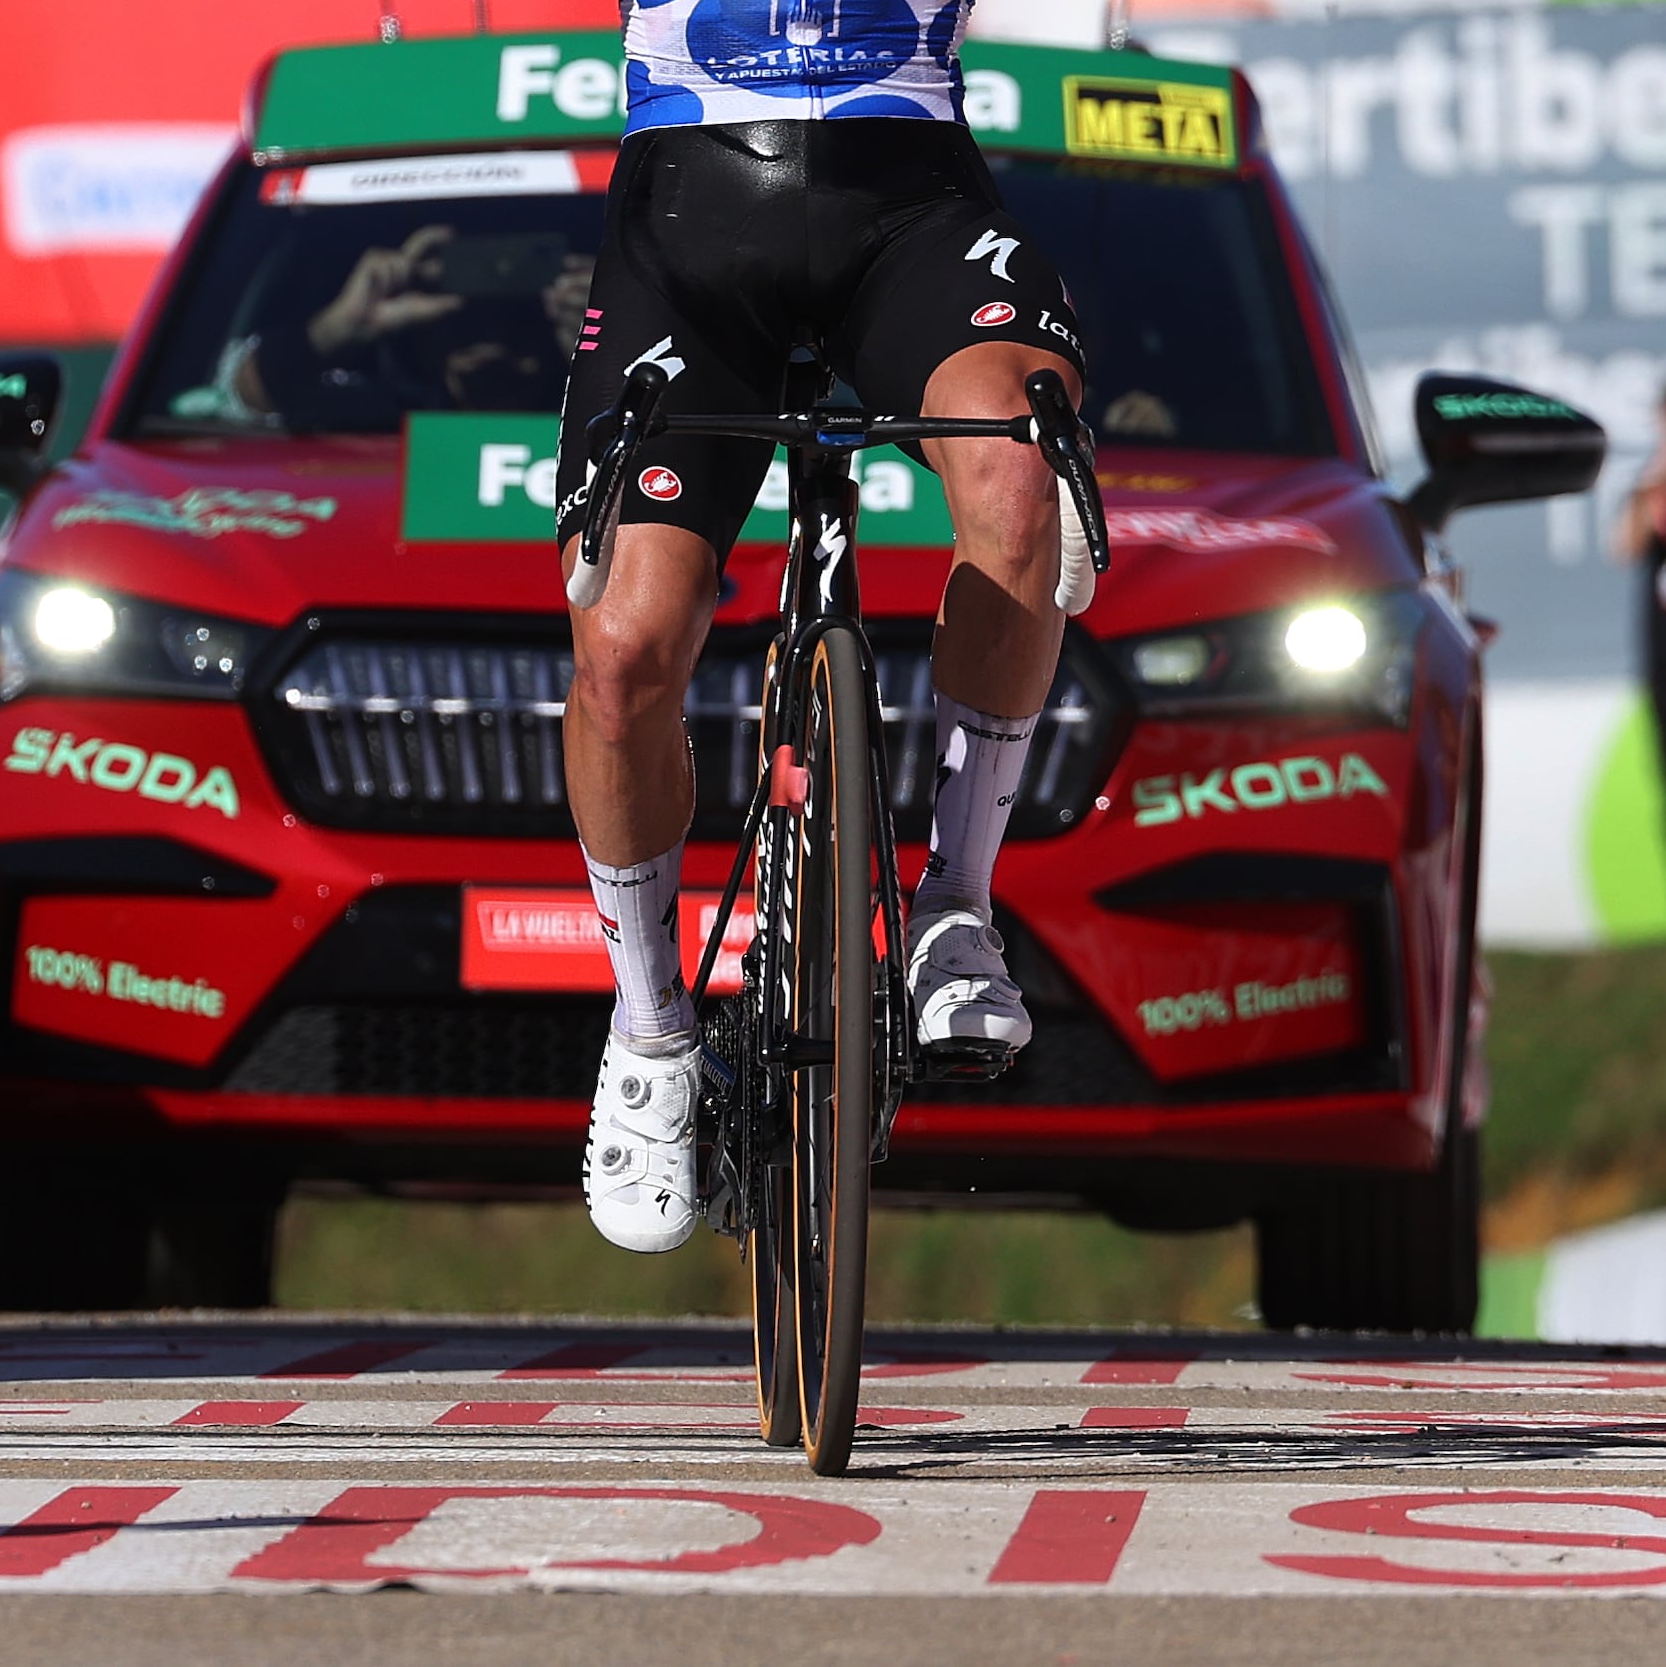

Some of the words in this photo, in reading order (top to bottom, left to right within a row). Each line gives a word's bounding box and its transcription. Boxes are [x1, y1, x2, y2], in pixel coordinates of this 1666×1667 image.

[827, 416, 863, 425] GARMIN
[25, 944, 104, 995] 100%
[106, 960, 226, 1020] Electric
[1139, 988, 1230, 1037] 100%
